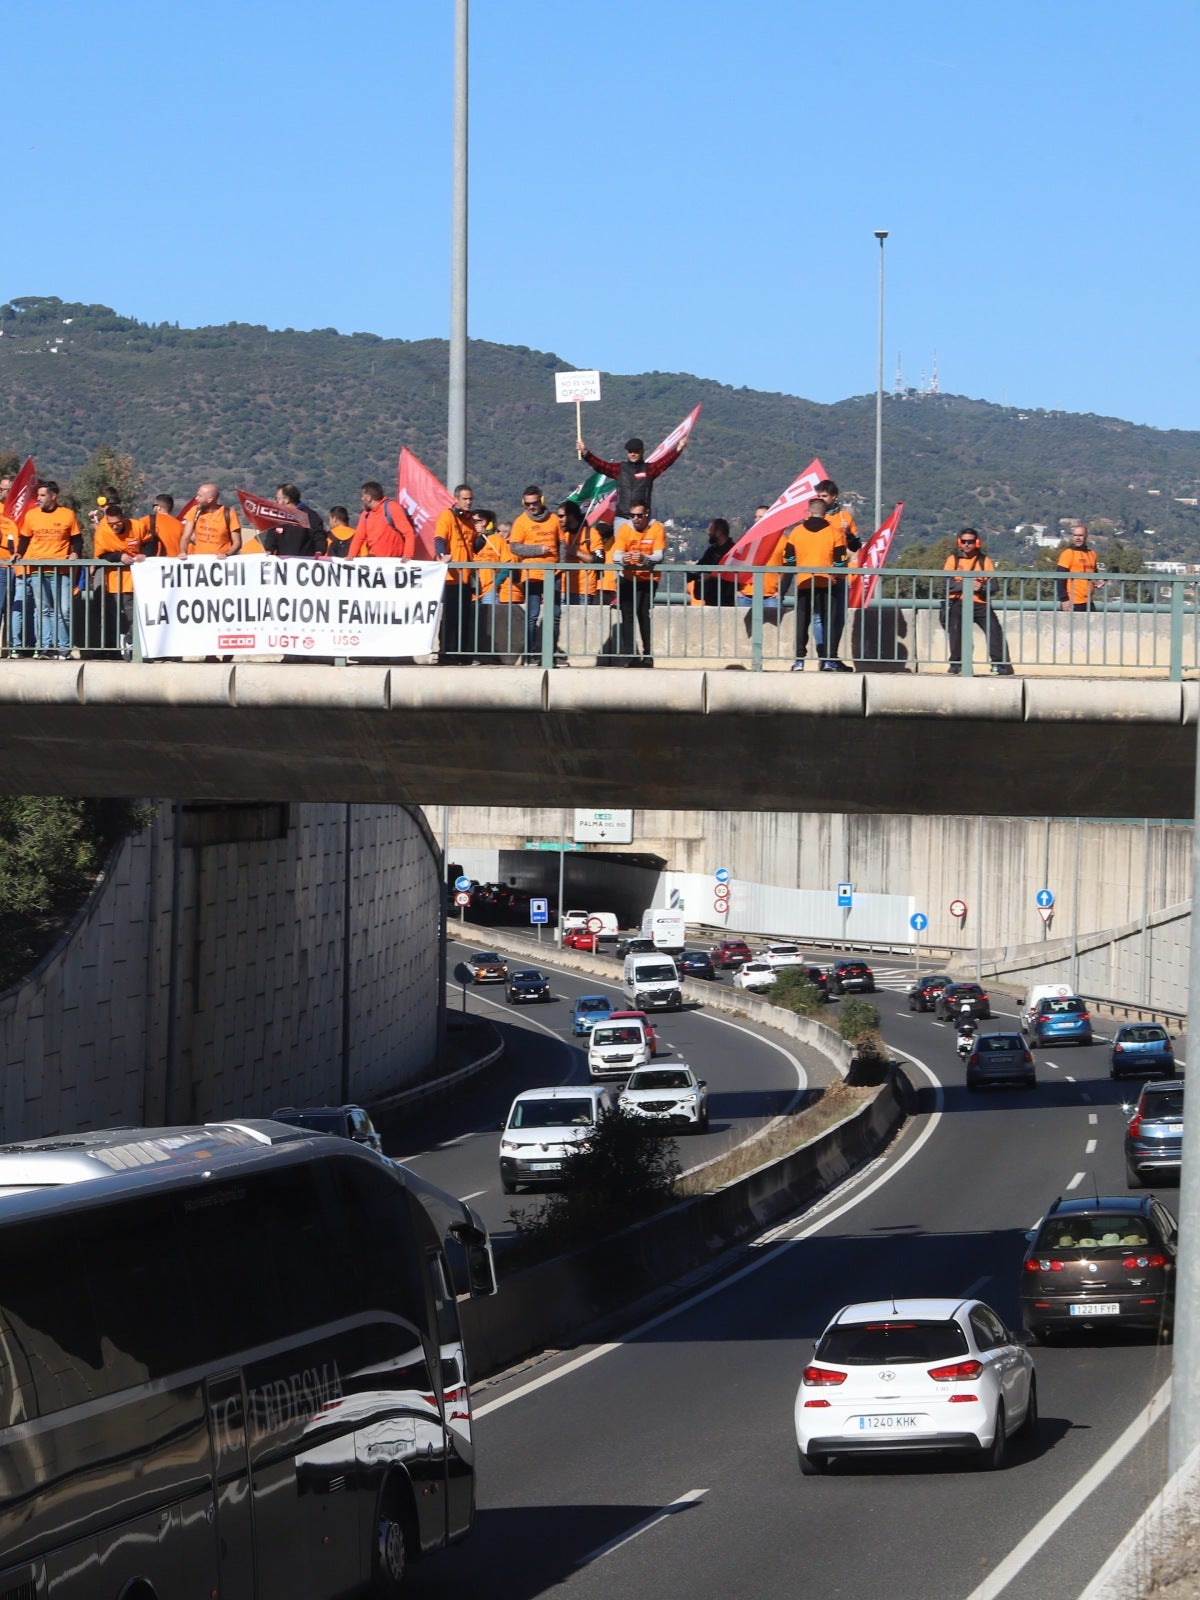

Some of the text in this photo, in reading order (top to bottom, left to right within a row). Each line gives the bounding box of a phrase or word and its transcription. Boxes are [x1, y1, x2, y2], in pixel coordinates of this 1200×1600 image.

[161, 561, 423, 589] HITACHI EN CONTRA DE
[144, 597, 438, 626] LA CONCILIACION FAMILIAR
[268, 635, 300, 648] UGT
[1078, 1305, 1117, 1314] 1221 FYP
[868, 1416, 917, 1428] 1240 KHK
